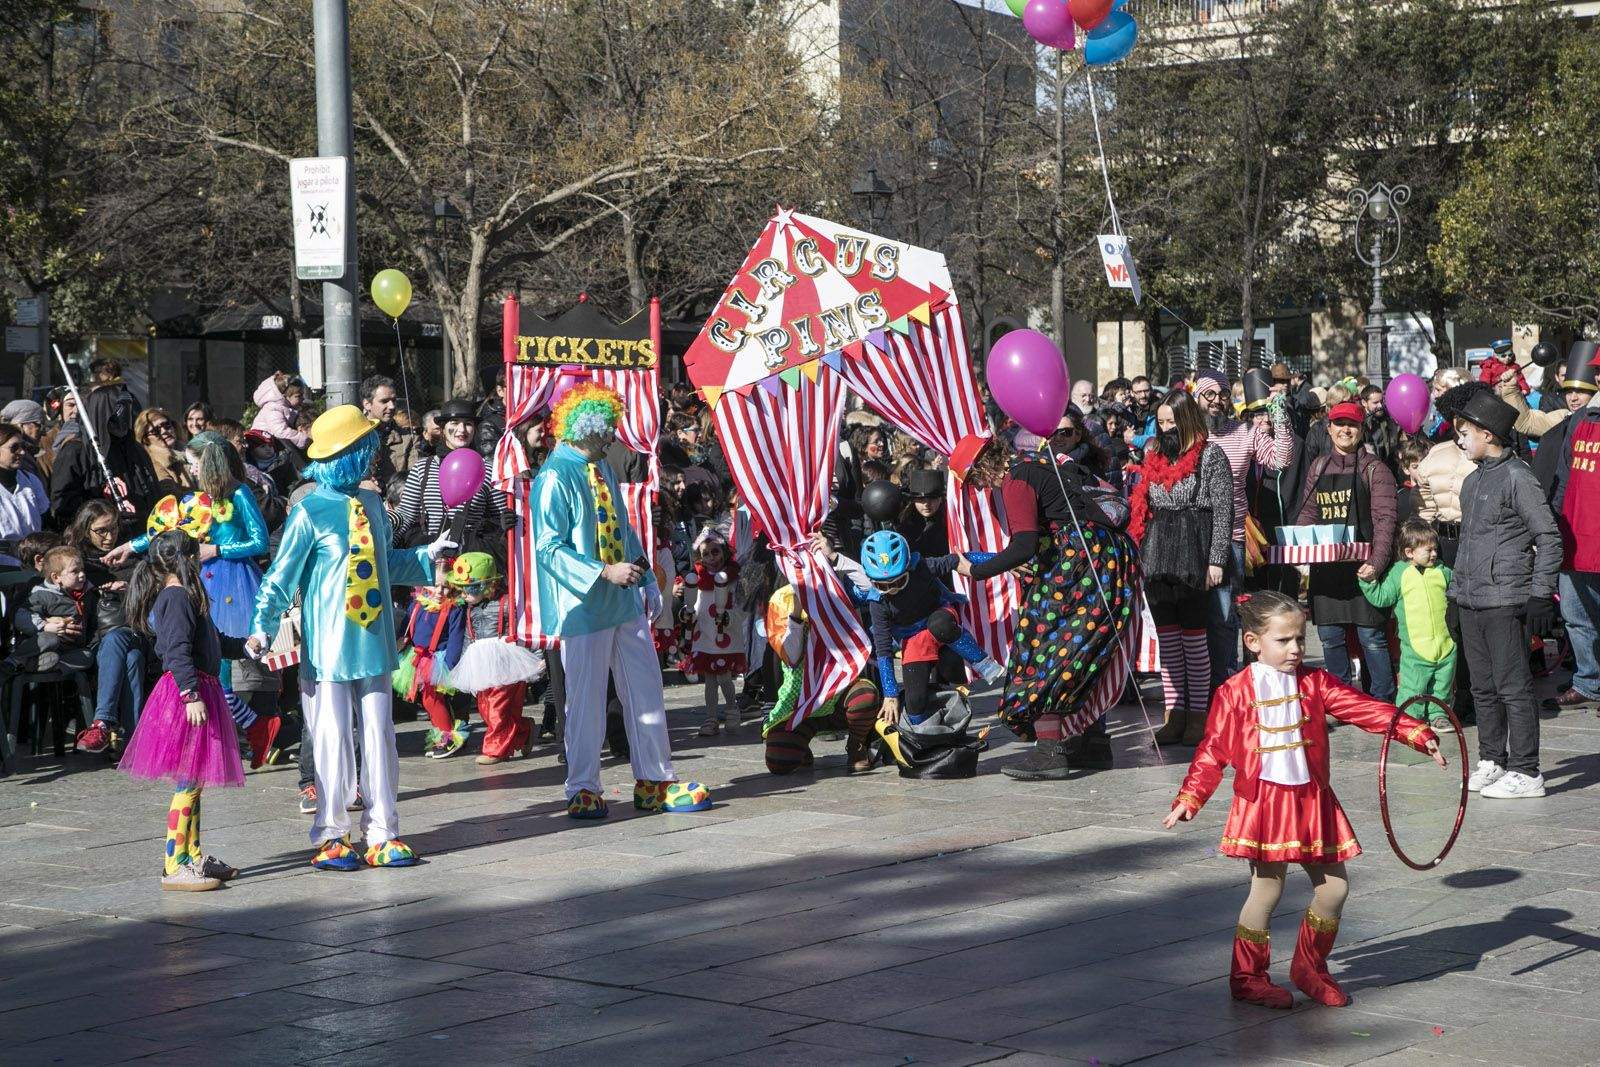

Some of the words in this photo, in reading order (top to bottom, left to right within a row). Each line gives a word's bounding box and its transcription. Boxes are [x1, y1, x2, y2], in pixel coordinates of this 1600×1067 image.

[708, 234, 899, 352] CIRCUS
[753, 288, 890, 370] PINS
[513, 335, 658, 367] TICKETS
